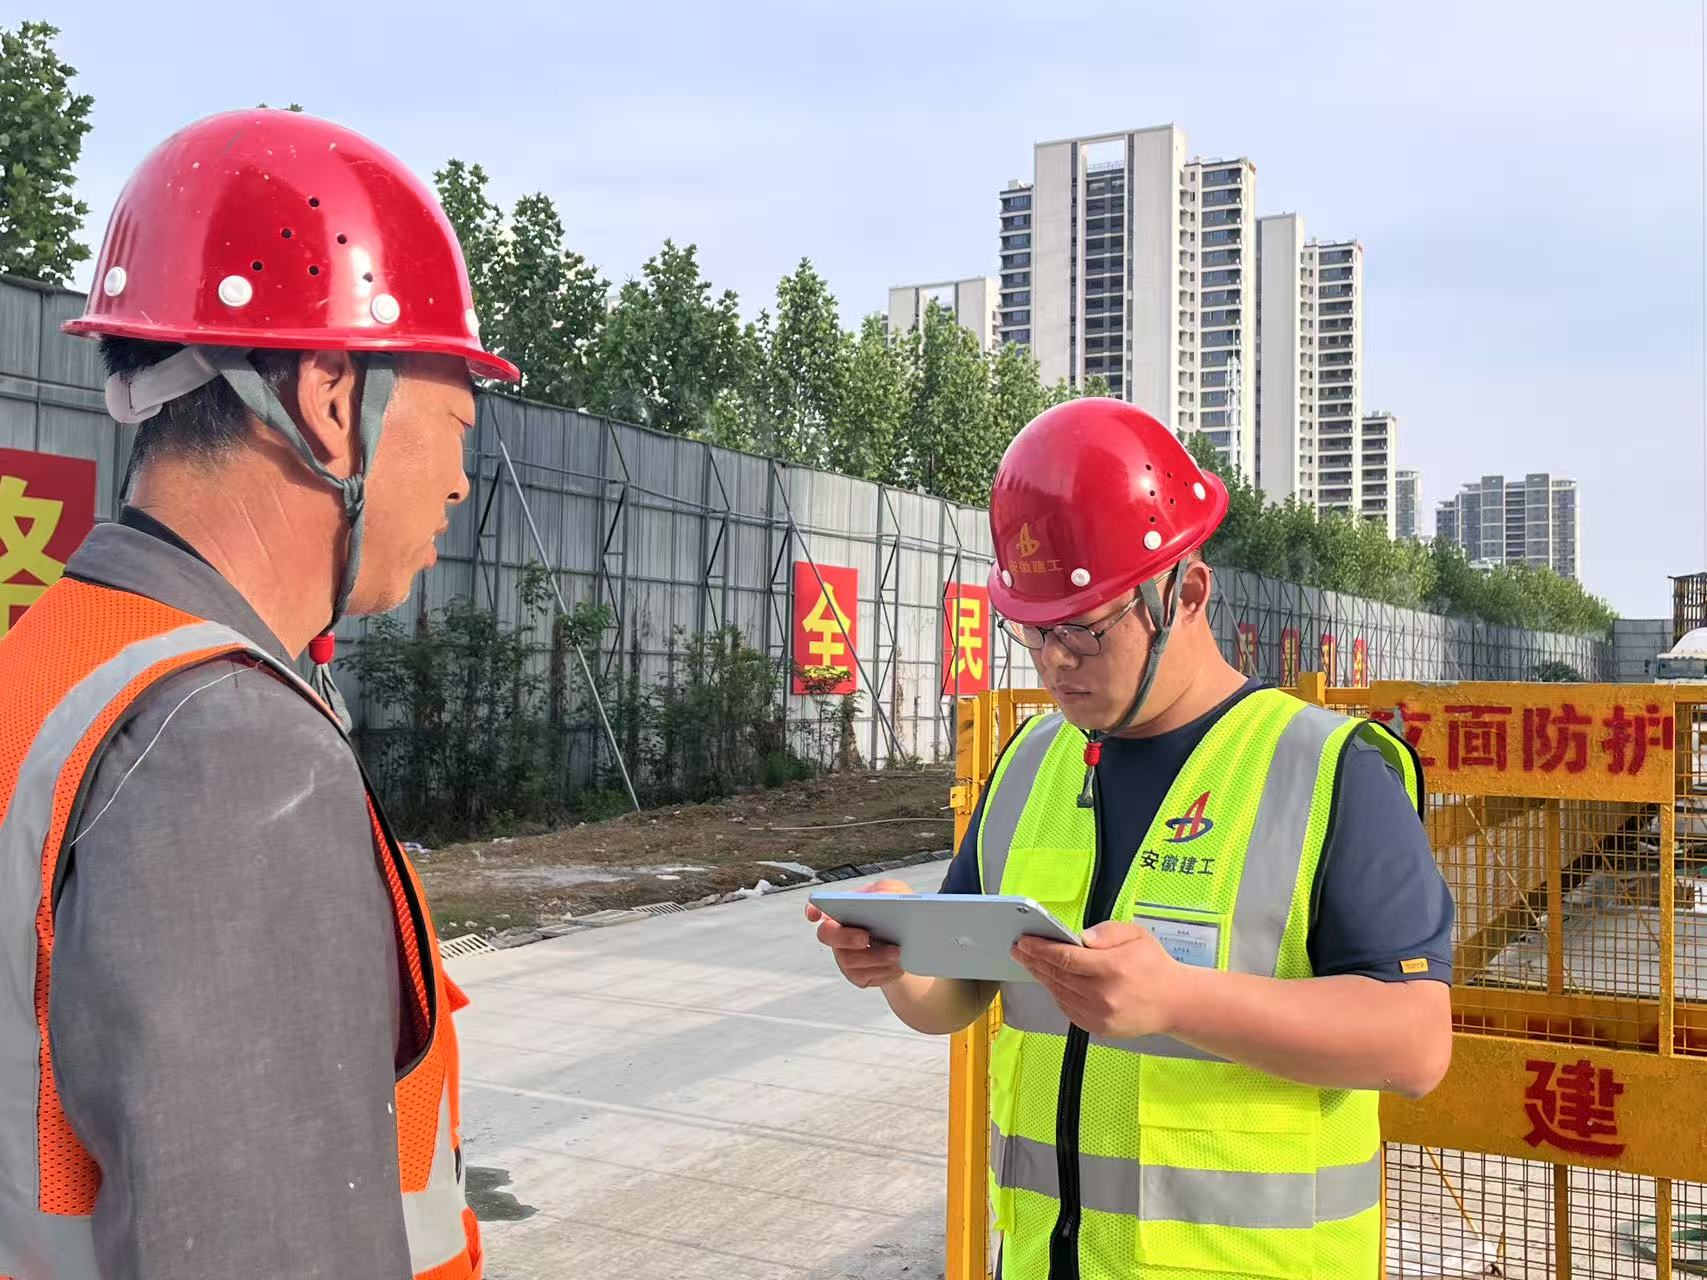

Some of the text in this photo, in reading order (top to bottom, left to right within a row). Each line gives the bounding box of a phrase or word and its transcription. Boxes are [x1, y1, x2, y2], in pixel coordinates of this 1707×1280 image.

[1140, 850, 1215, 875] 安徽建工
[1523, 1059, 1629, 1157] 建
